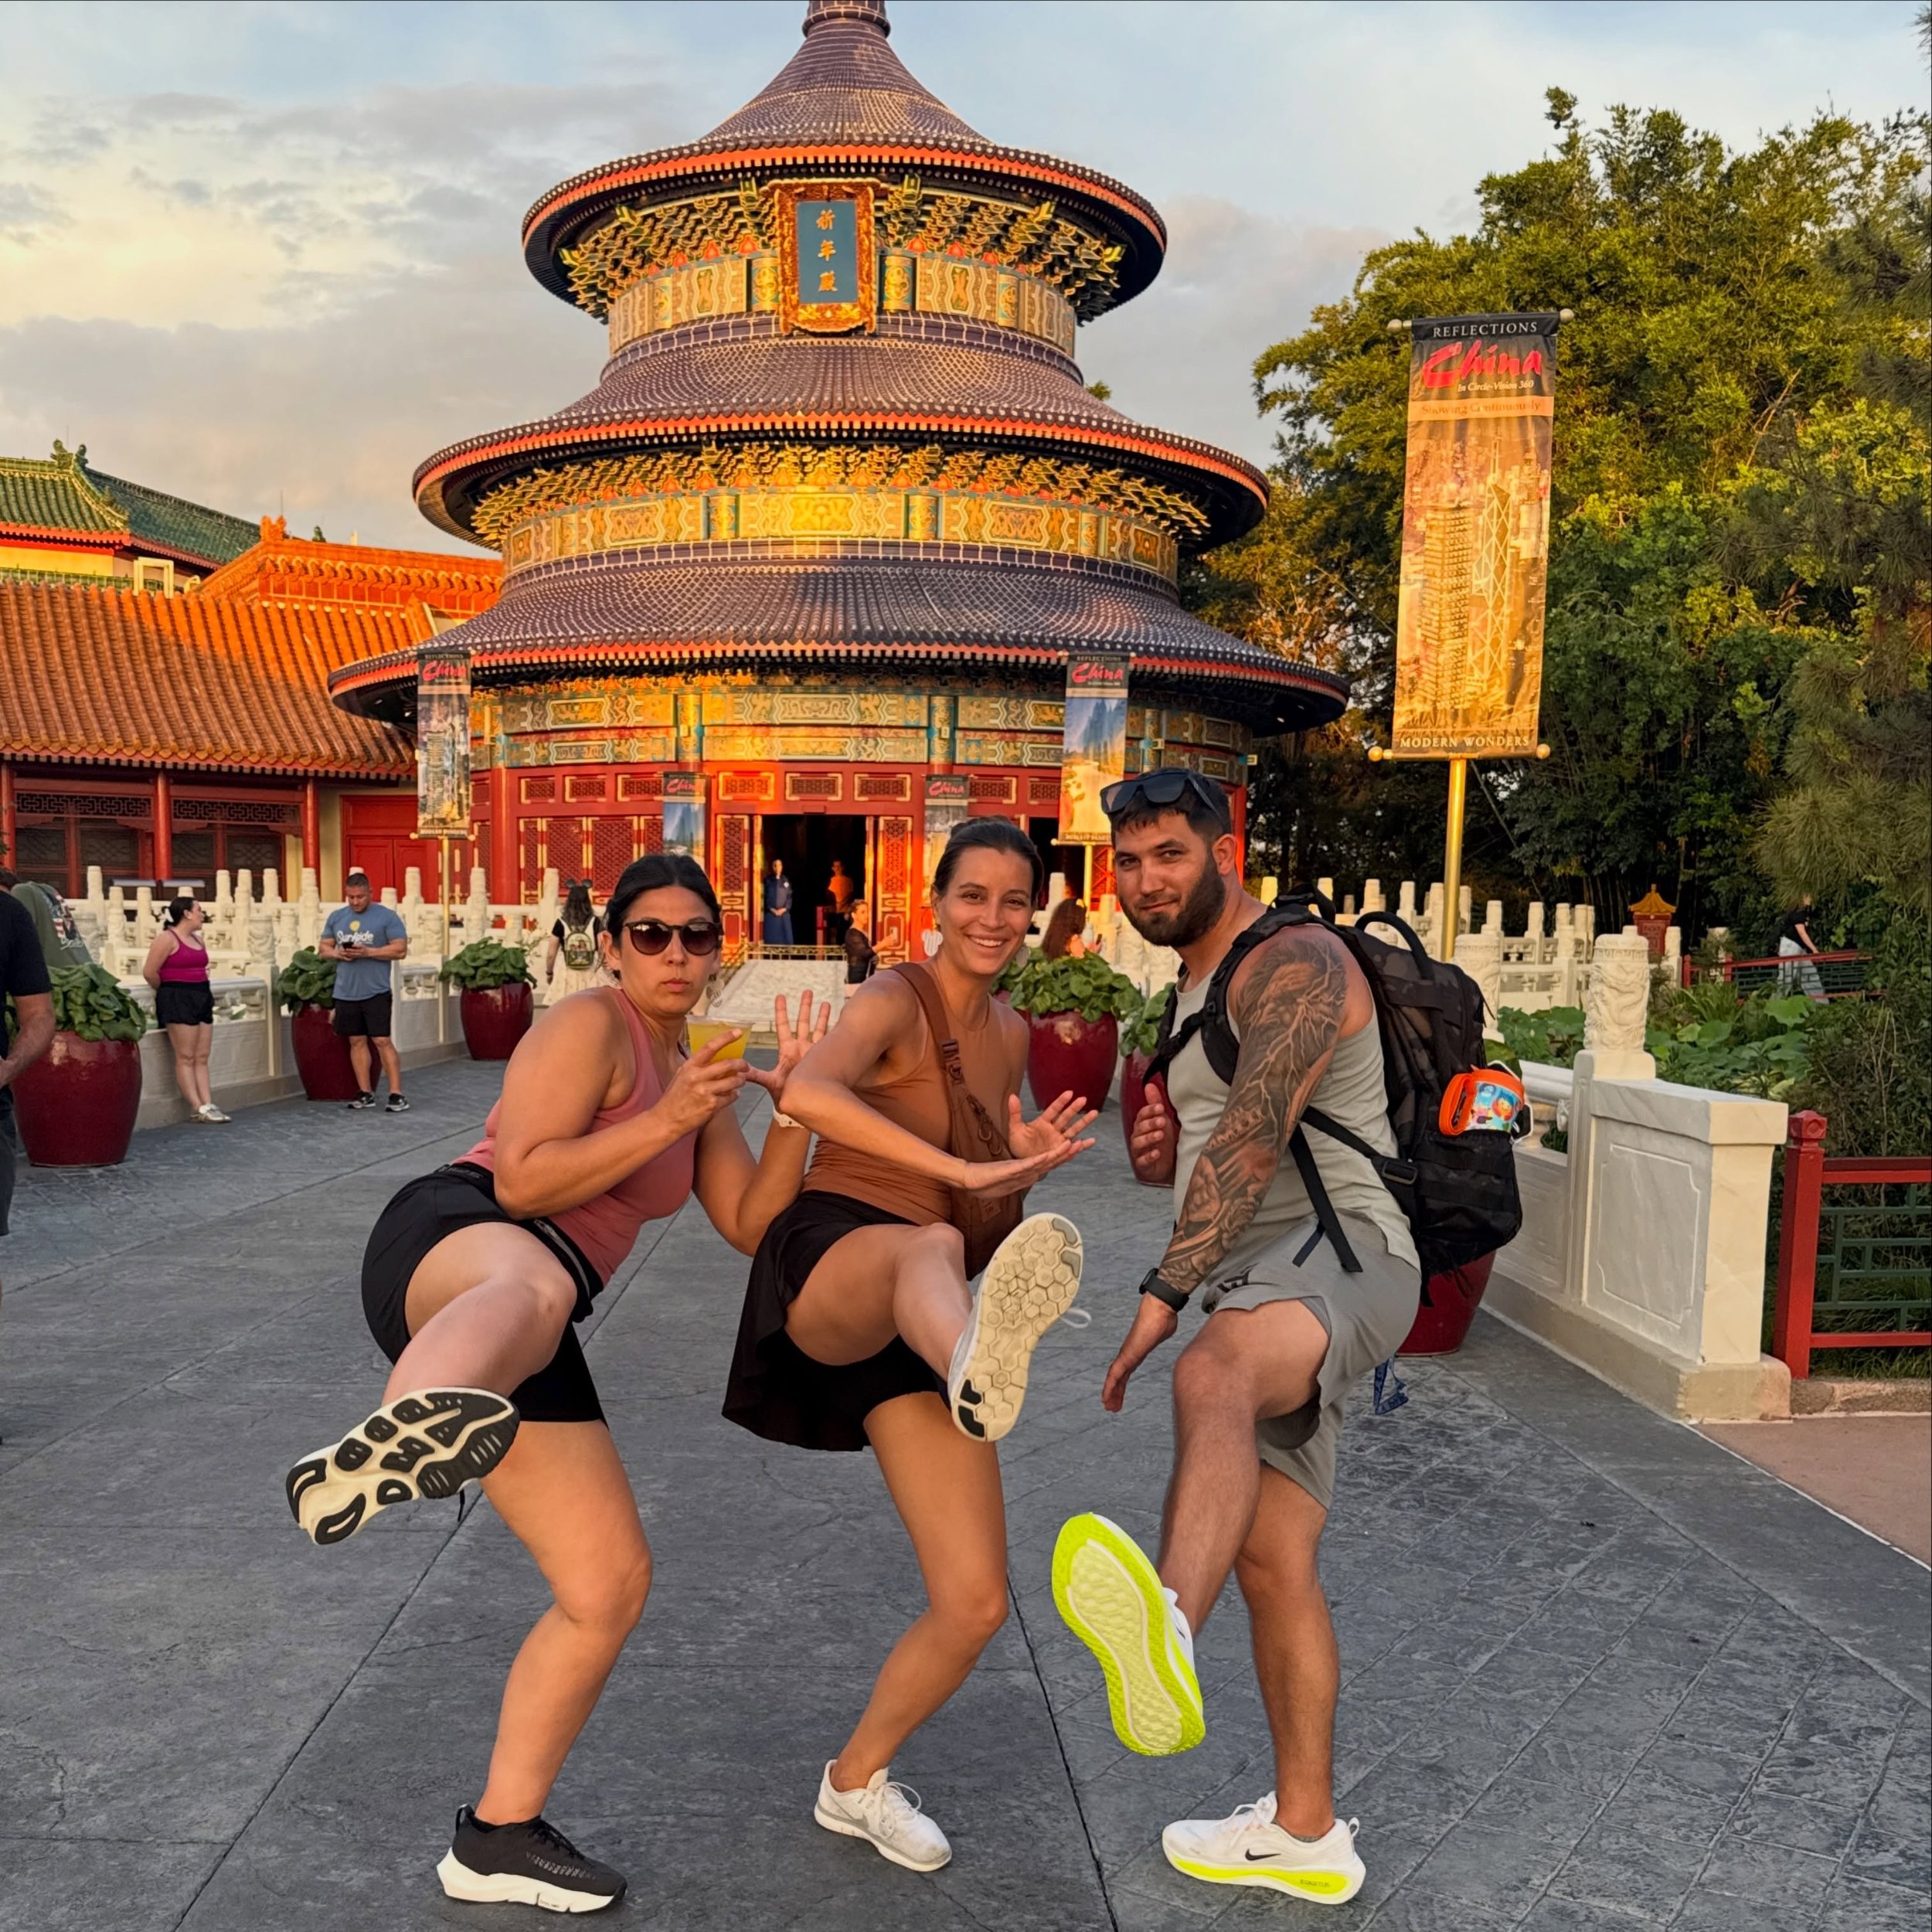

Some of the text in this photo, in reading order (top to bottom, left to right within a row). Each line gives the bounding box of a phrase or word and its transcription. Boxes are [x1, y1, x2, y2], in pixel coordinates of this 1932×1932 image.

[1433, 321, 1538, 338] REFLECTIONS
[1421, 339, 1543, 389] China
[1458, 383, 1467, 393] In
[1518, 379, 1535, 389] 360
[422, 660, 467, 682] China
[1071, 662, 1124, 684] China
[1400, 735, 1529, 748] MODERN WONDERS
[929, 781, 964, 796] China
